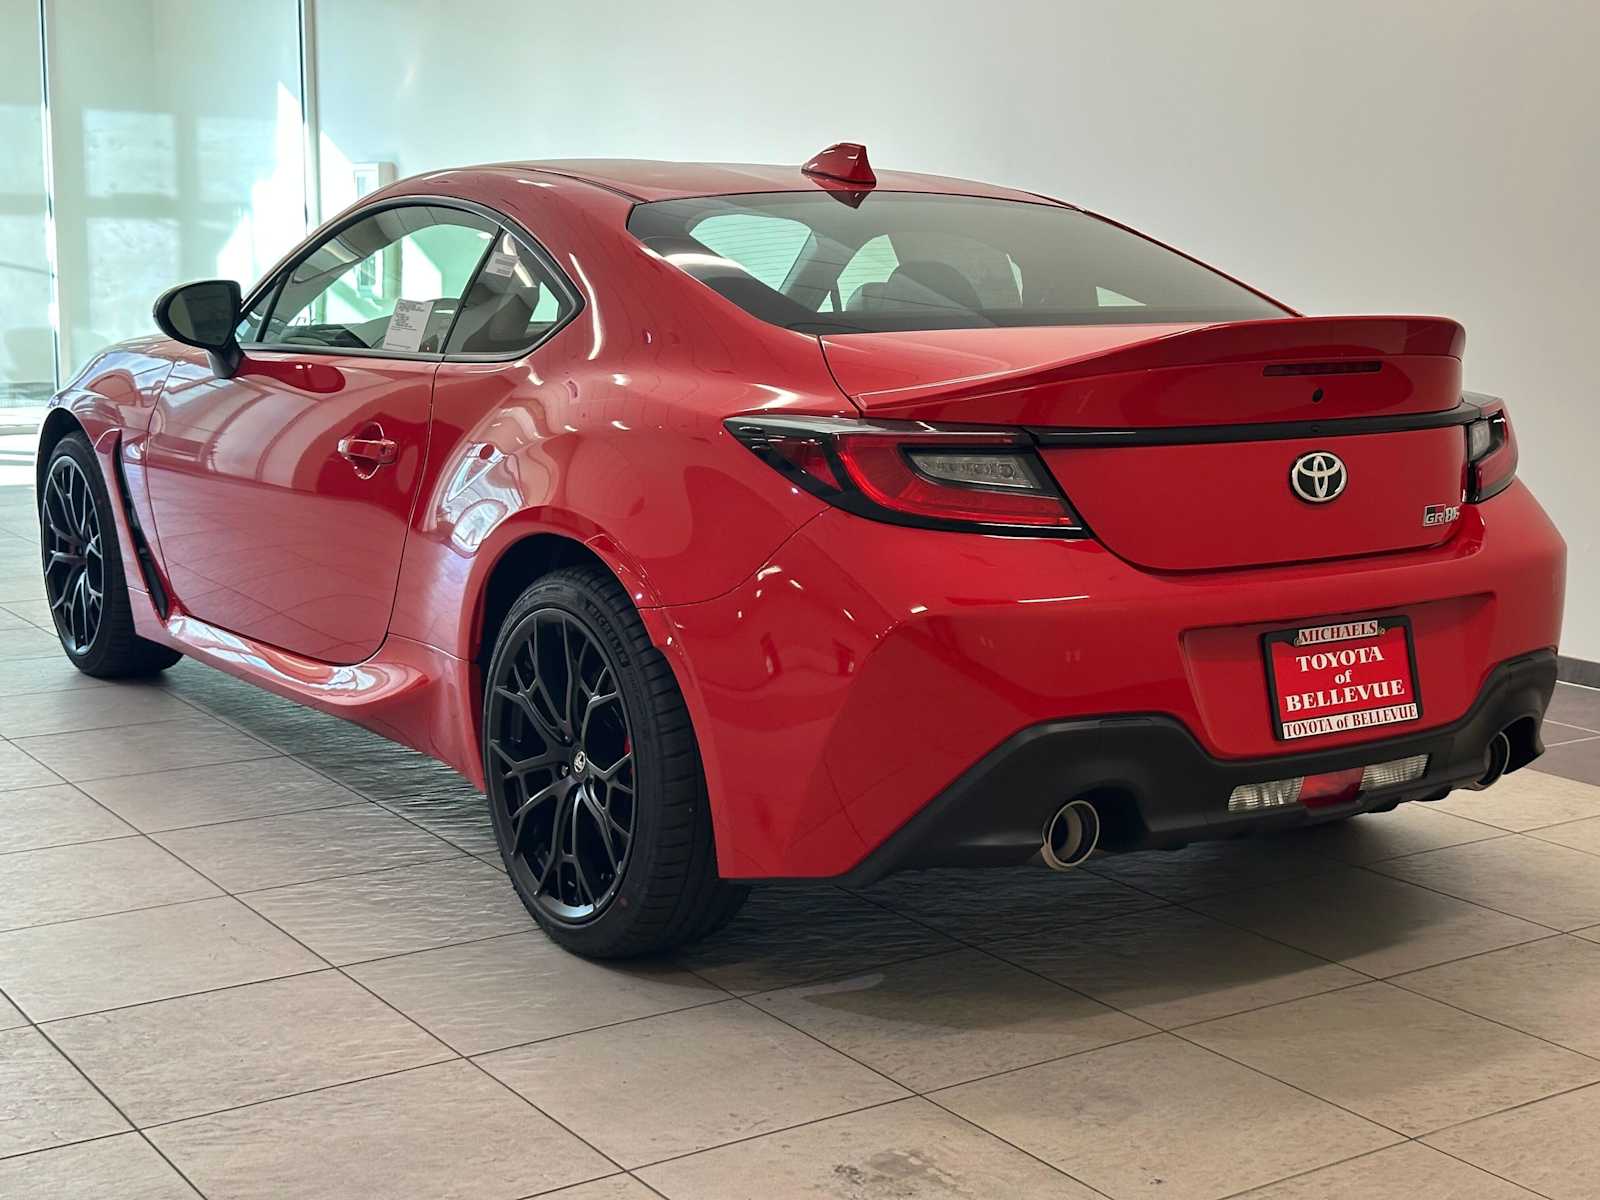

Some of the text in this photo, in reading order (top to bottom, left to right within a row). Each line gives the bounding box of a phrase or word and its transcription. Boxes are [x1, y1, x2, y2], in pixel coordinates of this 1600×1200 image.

[1300, 621, 1377, 643] MICHAELS
[1296, 646, 1384, 672] TOYOTA
[1334, 669, 1352, 685] of
[1285, 679, 1405, 712] BELLEVUE
[1284, 705, 1416, 737] TOYOTA of BELLEVUE
